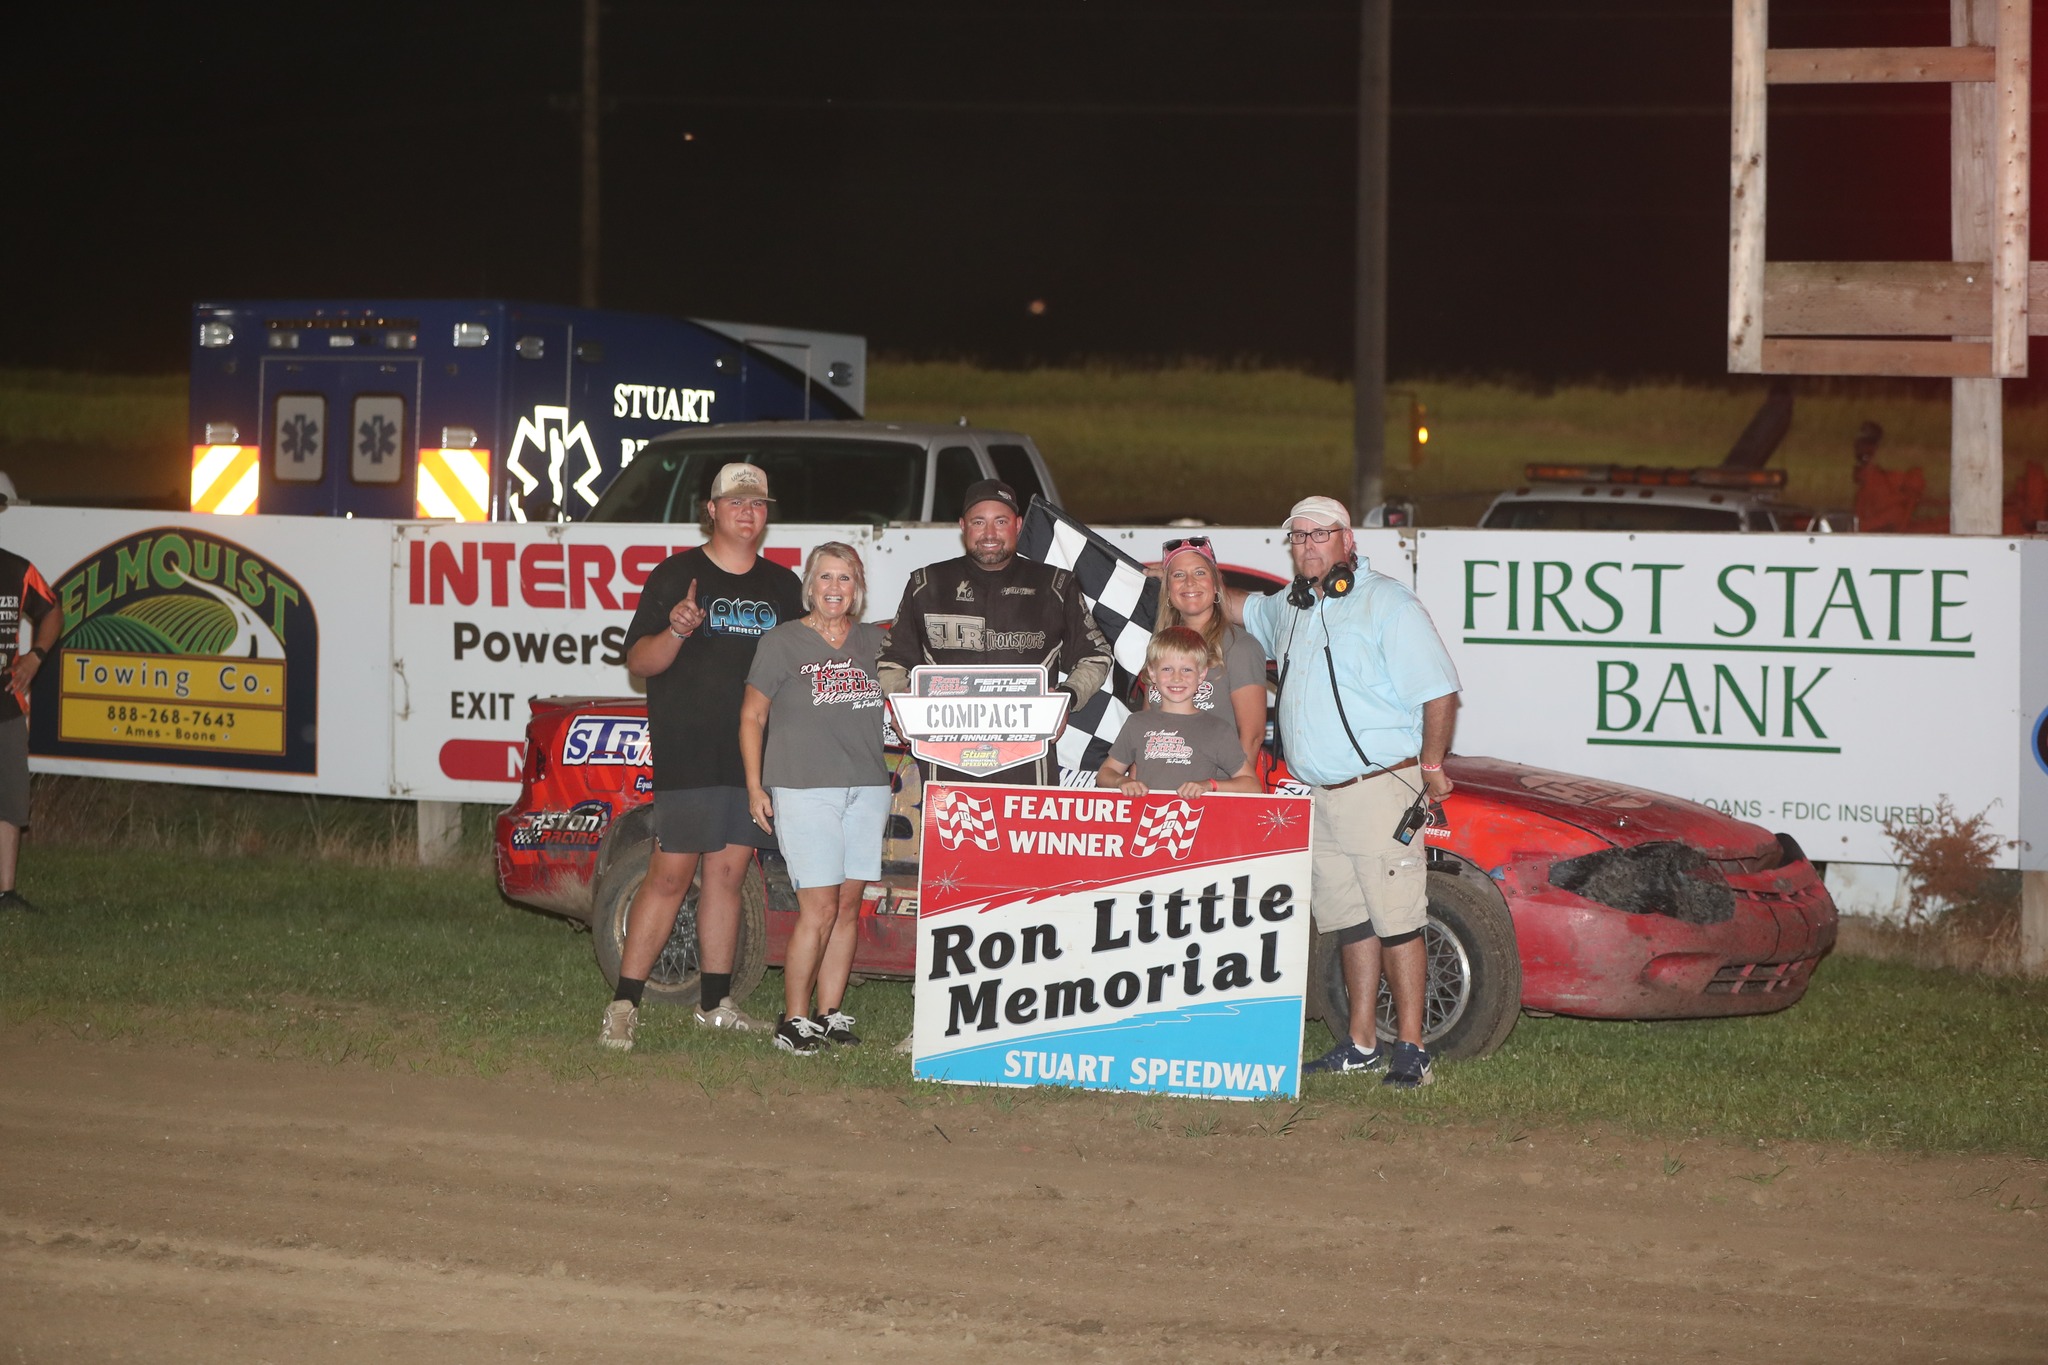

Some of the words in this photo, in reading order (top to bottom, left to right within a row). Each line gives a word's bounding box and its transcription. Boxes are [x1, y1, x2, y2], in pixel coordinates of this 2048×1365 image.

[614, 383, 715, 422] STUART
[60, 534, 298, 645] ELMQUIST
[1463, 560, 1685, 634] FIRST
[1713, 564, 1973, 643] STATE
[710, 598, 776, 630] RICO
[455, 622, 627, 666] PowerS
[924, 614, 986, 651] STR
[984, 629, 1045, 652] Transport
[76, 658, 190, 697] Towing
[219, 666, 271, 692] Co.
[800, 663, 820, 674] 20th
[822, 658, 852, 671] Annual
[814, 669, 865, 681] Ron
[813, 679, 880, 693] Little
[813, 690, 881, 705] Memorial
[1596, 660, 1832, 739] BANK
[107, 706, 235, 728] 888-268-7643
[451, 691, 514, 721] EXIT
[926, 704, 1032, 728] COMPACT
[125, 725, 161, 738] Ames
[175, 728, 216, 742] Boone
[567, 719, 645, 760] STR
[962, 750, 998, 759] Stuart
[1004, 796, 1132, 822] FEATURE
[1783, 801, 1831, 820] FDIC
[1839, 805, 1934, 825] INSURED
[540, 831, 600, 844] RACING
[1009, 831, 1123, 857] WINNER
[929, 925, 1062, 981] Ron
[1092, 875, 1293, 953] Little
[945, 932, 1281, 1037] Memorial
[1004, 1050, 1114, 1083] STUART
[1130, 1057, 1286, 1092] SPEEDWAY
